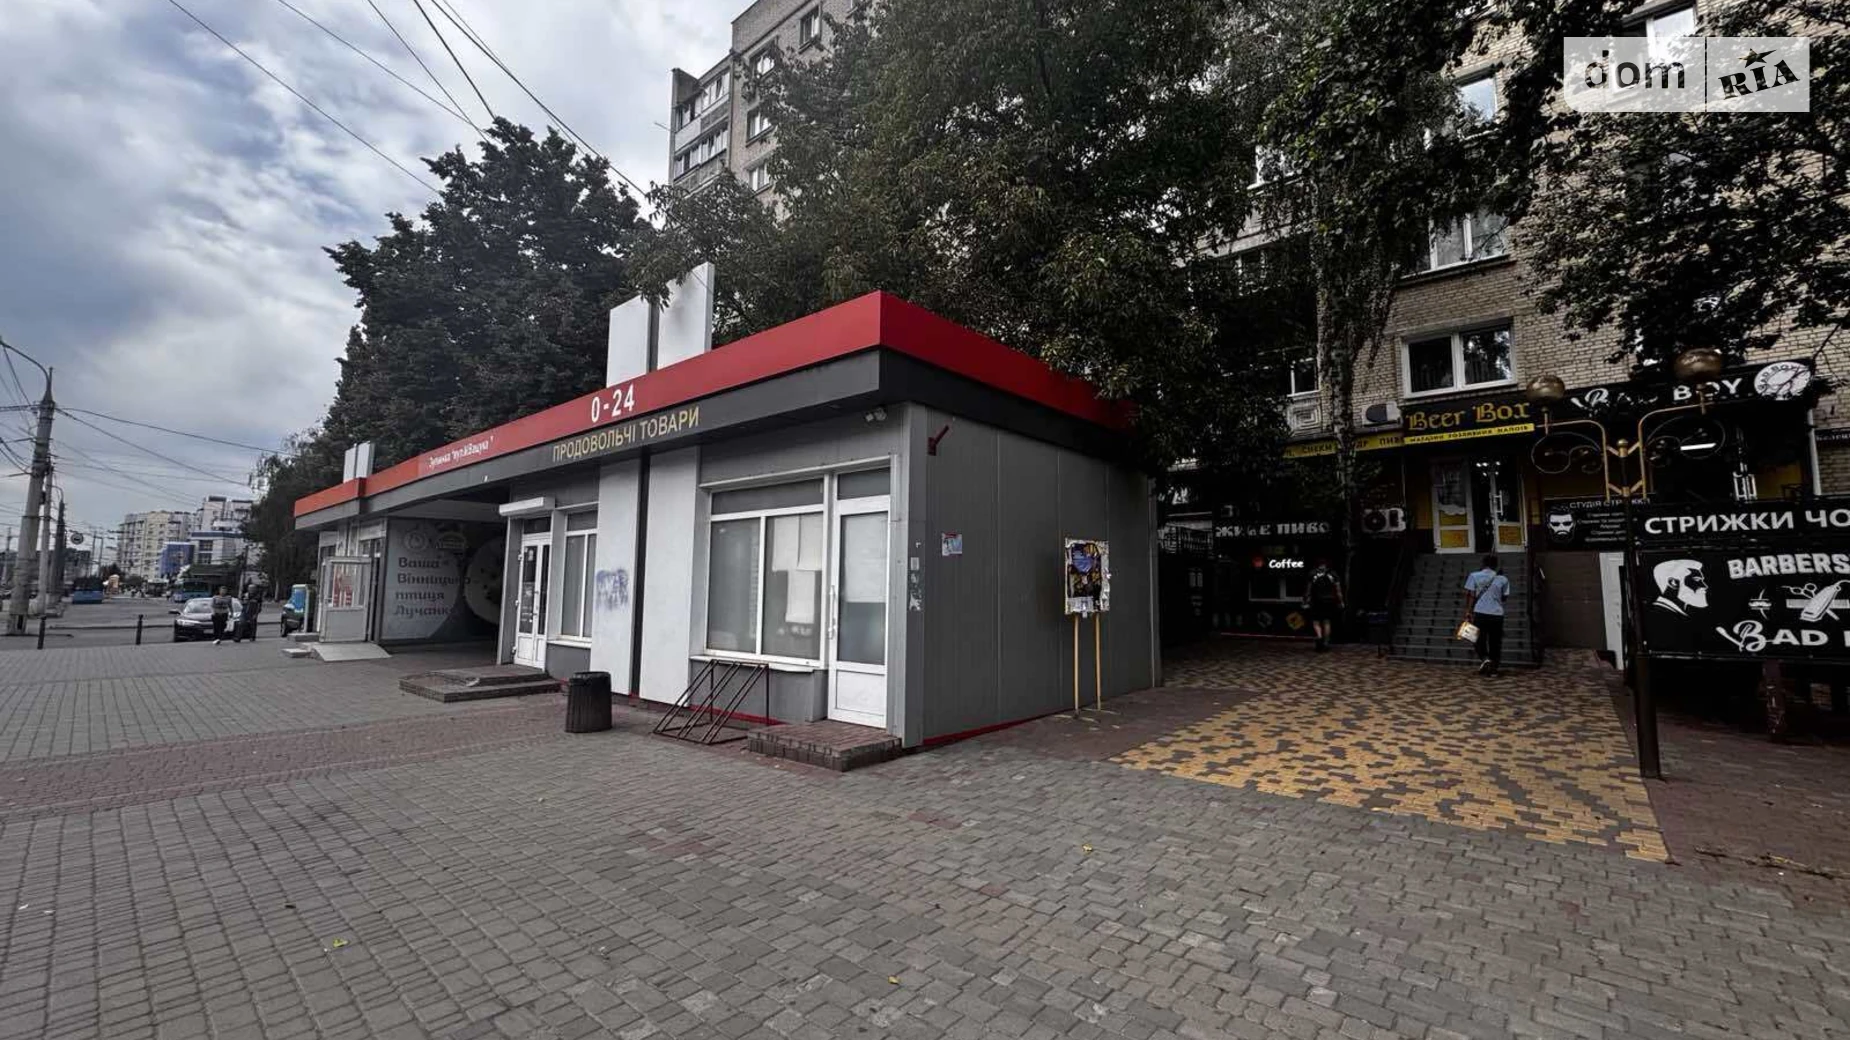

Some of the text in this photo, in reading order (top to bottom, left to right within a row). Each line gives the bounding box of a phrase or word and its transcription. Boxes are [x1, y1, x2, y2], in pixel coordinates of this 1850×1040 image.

[1408, 402, 1531, 431] Beer Box
[552, 406, 700, 462] ПРОДОВОЛЬЧІ ТОВАРИ
[1603, 497, 1651, 507] СТРЖКИ
[1644, 509, 1850, 534] СТРИЖКИ ЧО
[398, 557, 440, 569] Ваша
[1268, 558, 1304, 569] Coffee
[1727, 553, 1850, 580] BARBERS
[1716, 620, 1829, 652] BAD
